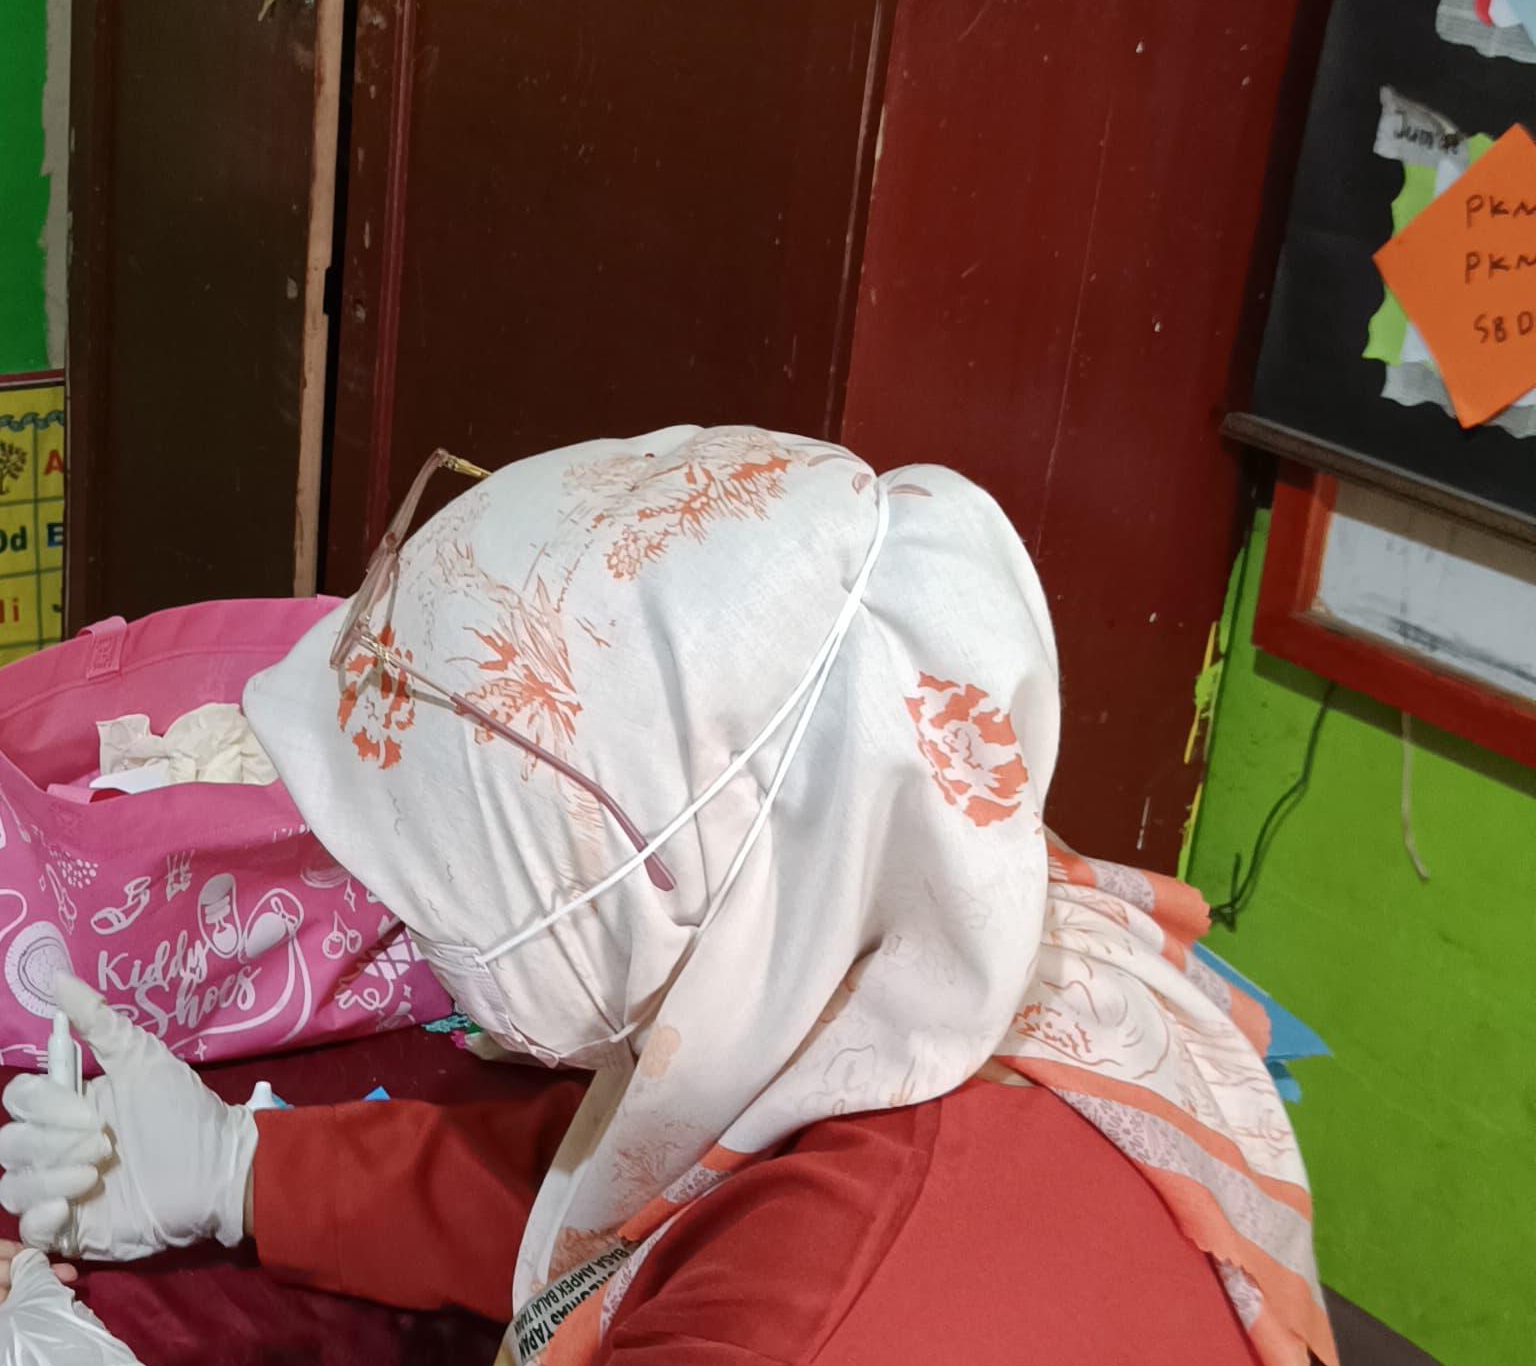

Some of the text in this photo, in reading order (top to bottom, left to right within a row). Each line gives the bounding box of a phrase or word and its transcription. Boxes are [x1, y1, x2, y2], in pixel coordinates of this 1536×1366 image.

[98, 930, 210, 992] Kiddy
[134, 965, 262, 1037] Shoes
[529, 1288, 560, 1319] BALAI
[554, 1264, 597, 1296] AMPEK
